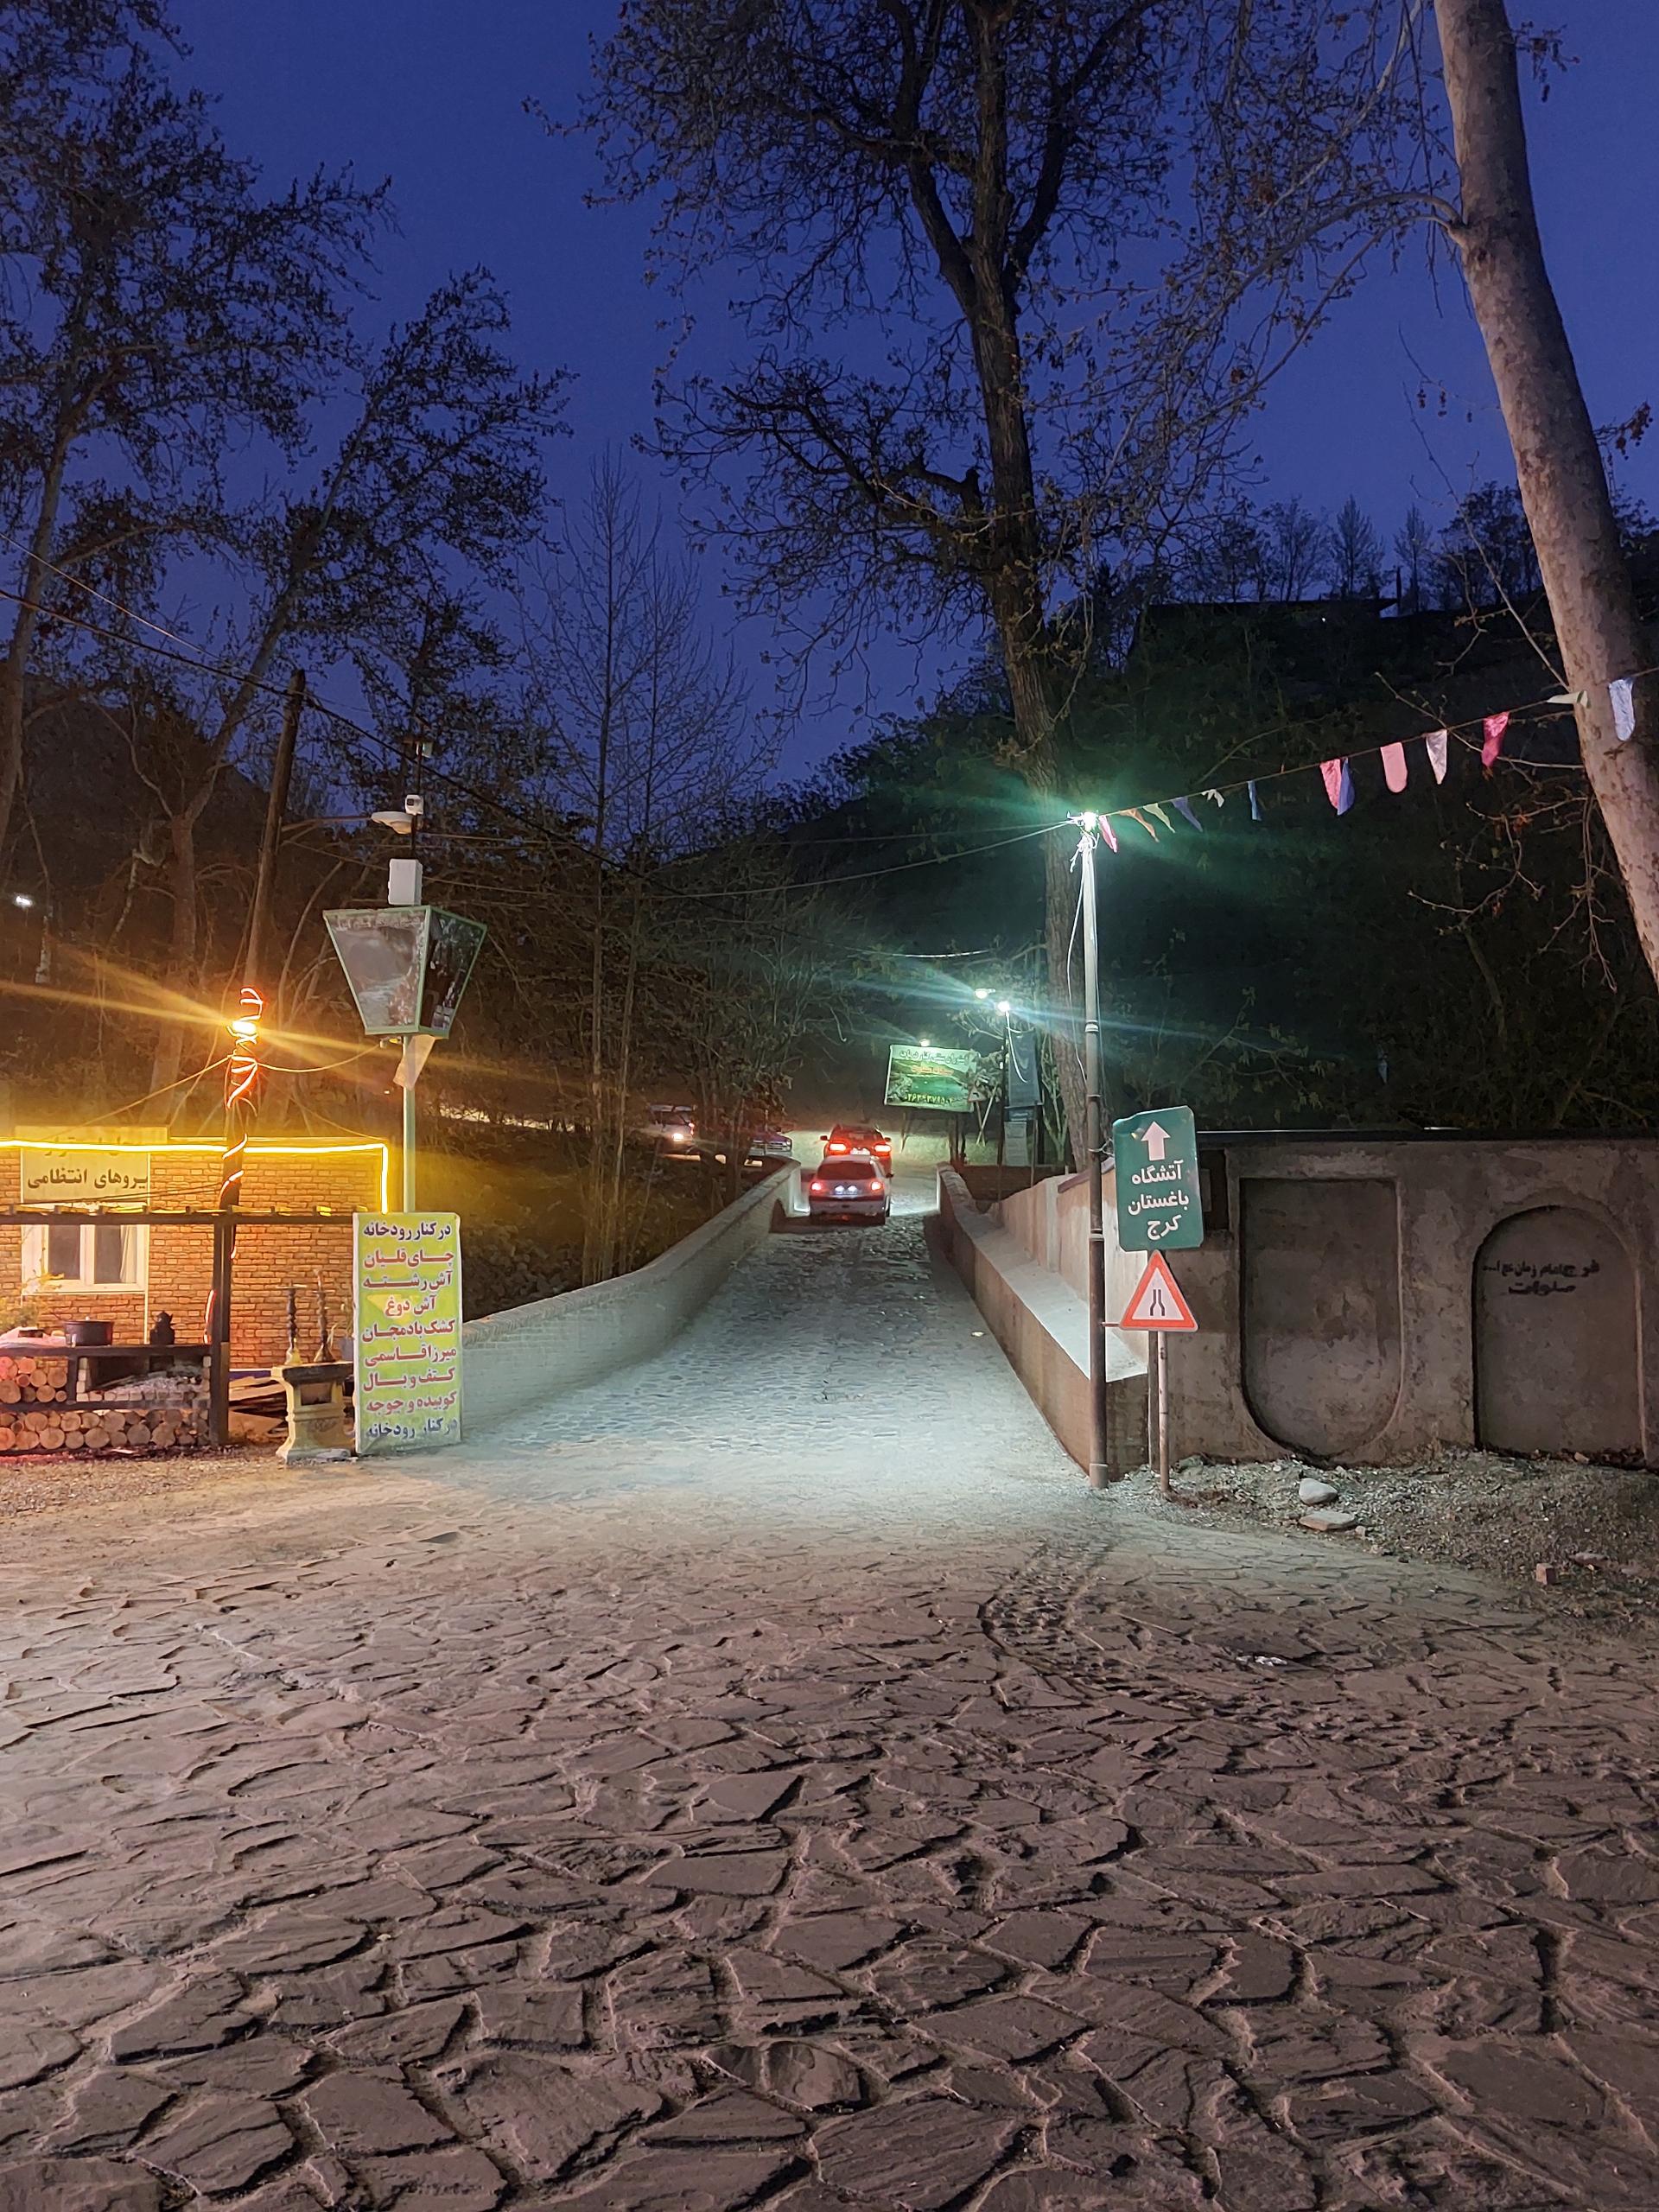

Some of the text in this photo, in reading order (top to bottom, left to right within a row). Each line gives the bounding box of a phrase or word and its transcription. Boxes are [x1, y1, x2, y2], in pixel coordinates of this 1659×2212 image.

[28, 1167, 148, 1189] یروهای انتظامی
[1131, 1160, 1184, 1185] آتشگاه
[1128, 1190, 1190, 1215] باغستان
[364, 1222, 450, 1240] در کنار رودخانه
[1147, 1214, 1181, 1240] کرج
[364, 1249, 454, 1268] چای قلیان
[363, 1270, 452, 1290] آش رشته
[385, 1295, 436, 1316] آش دوغ
[362, 1319, 455, 1342] کشک بادمجان
[365, 1344, 456, 1366] میرزا قاسمی
[364, 1367, 455, 1391] کتف و بال
[366, 1391, 456, 1414] کوبیده و جوجه
[366, 1421, 415, 1440] رودخانه
